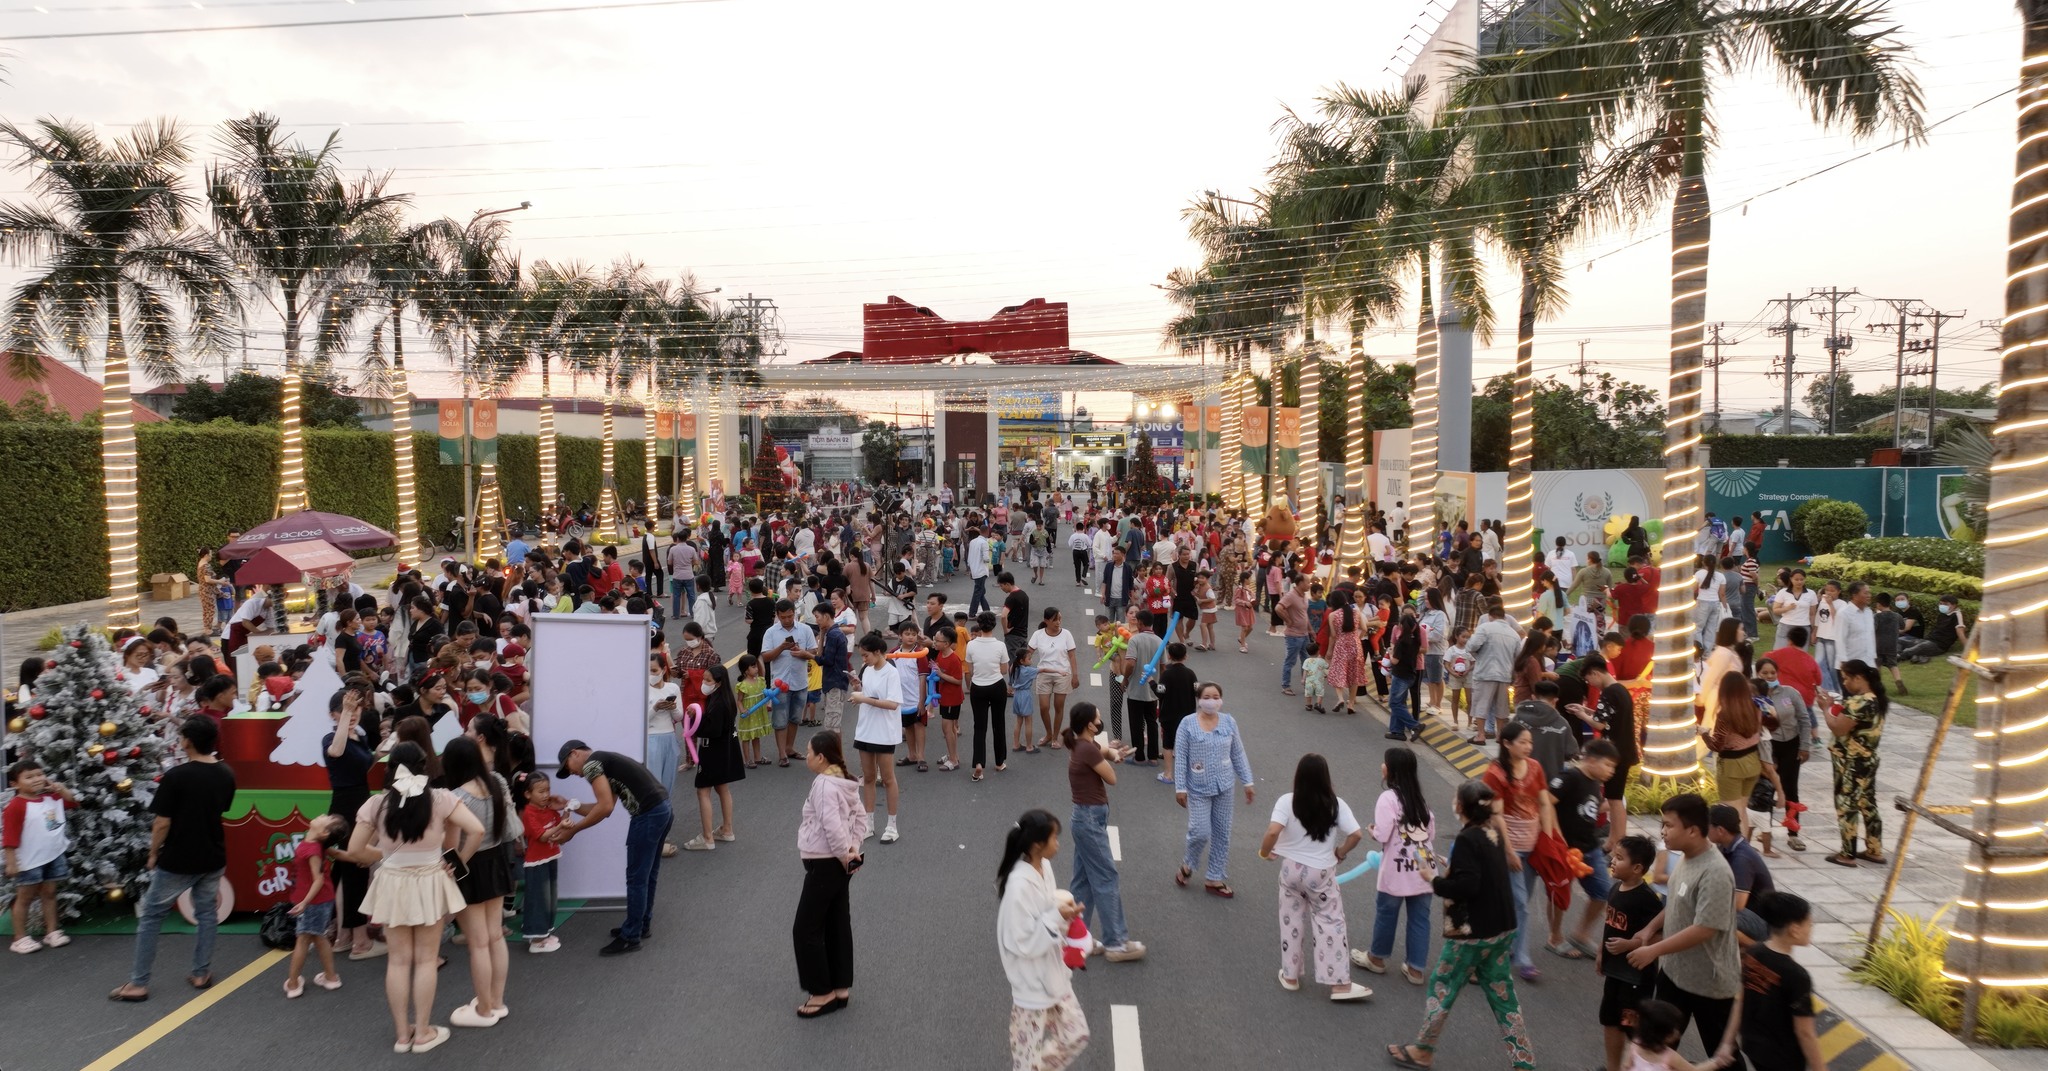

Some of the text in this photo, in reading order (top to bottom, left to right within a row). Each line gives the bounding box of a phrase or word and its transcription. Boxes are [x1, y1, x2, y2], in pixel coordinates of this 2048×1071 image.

[1135, 422, 1173, 432] LONG
[1758, 493, 1829, 502] Strategy Consulting
[1564, 531, 1608, 547] SOLI
[275, 833, 305, 861] ME
[258, 866, 293, 896] CHR
